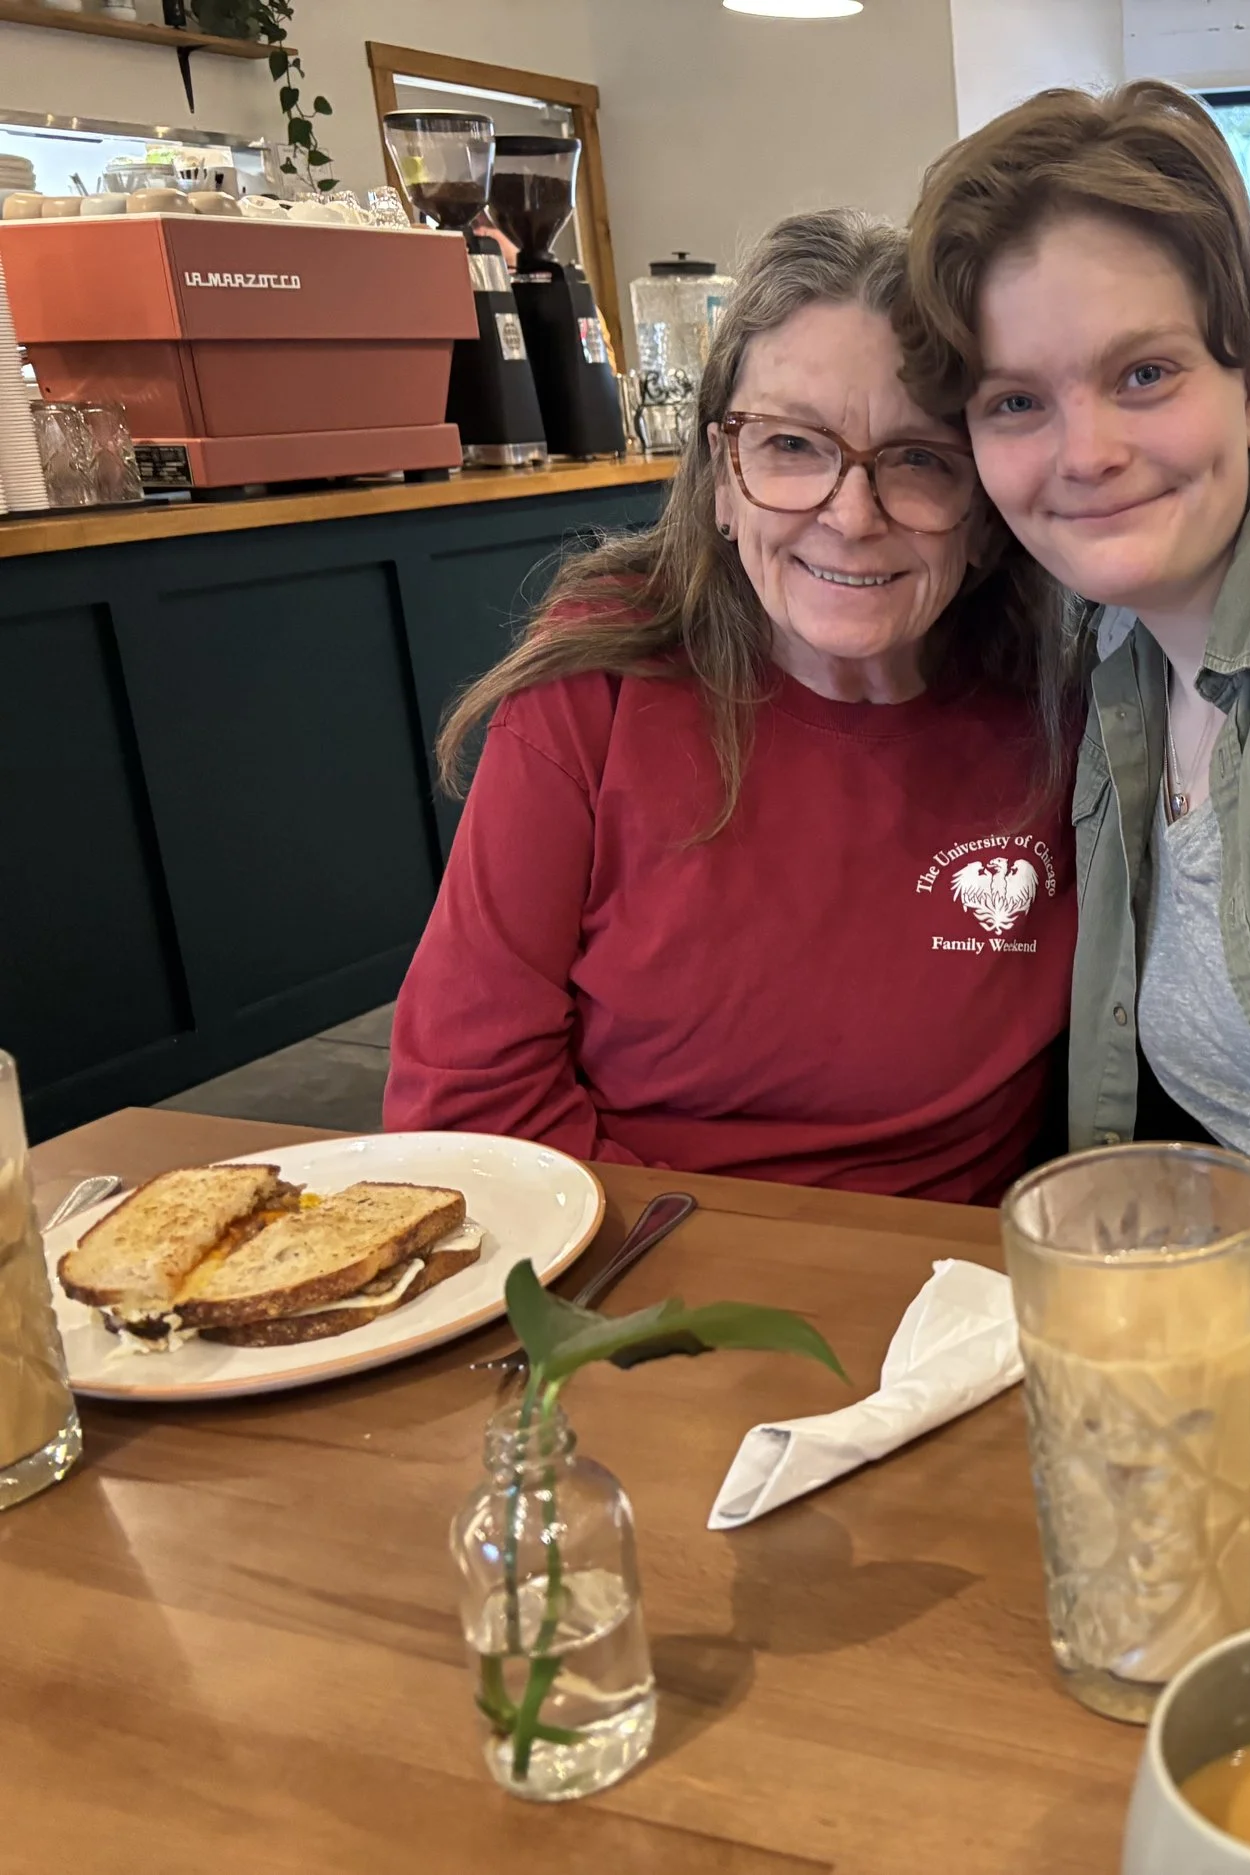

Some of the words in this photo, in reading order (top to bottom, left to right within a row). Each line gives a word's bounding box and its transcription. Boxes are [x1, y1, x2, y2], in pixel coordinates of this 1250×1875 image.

[184, 271, 202, 287] LA
[207, 272, 301, 289] MARZOCCO
[915, 865, 940, 894] The
[932, 833, 1011, 867] University
[1014, 834, 1033, 848] of
[1033, 841, 1057, 897] Chicago
[931, 936, 985, 955] Family
[988, 938, 1037, 953] Weekend
